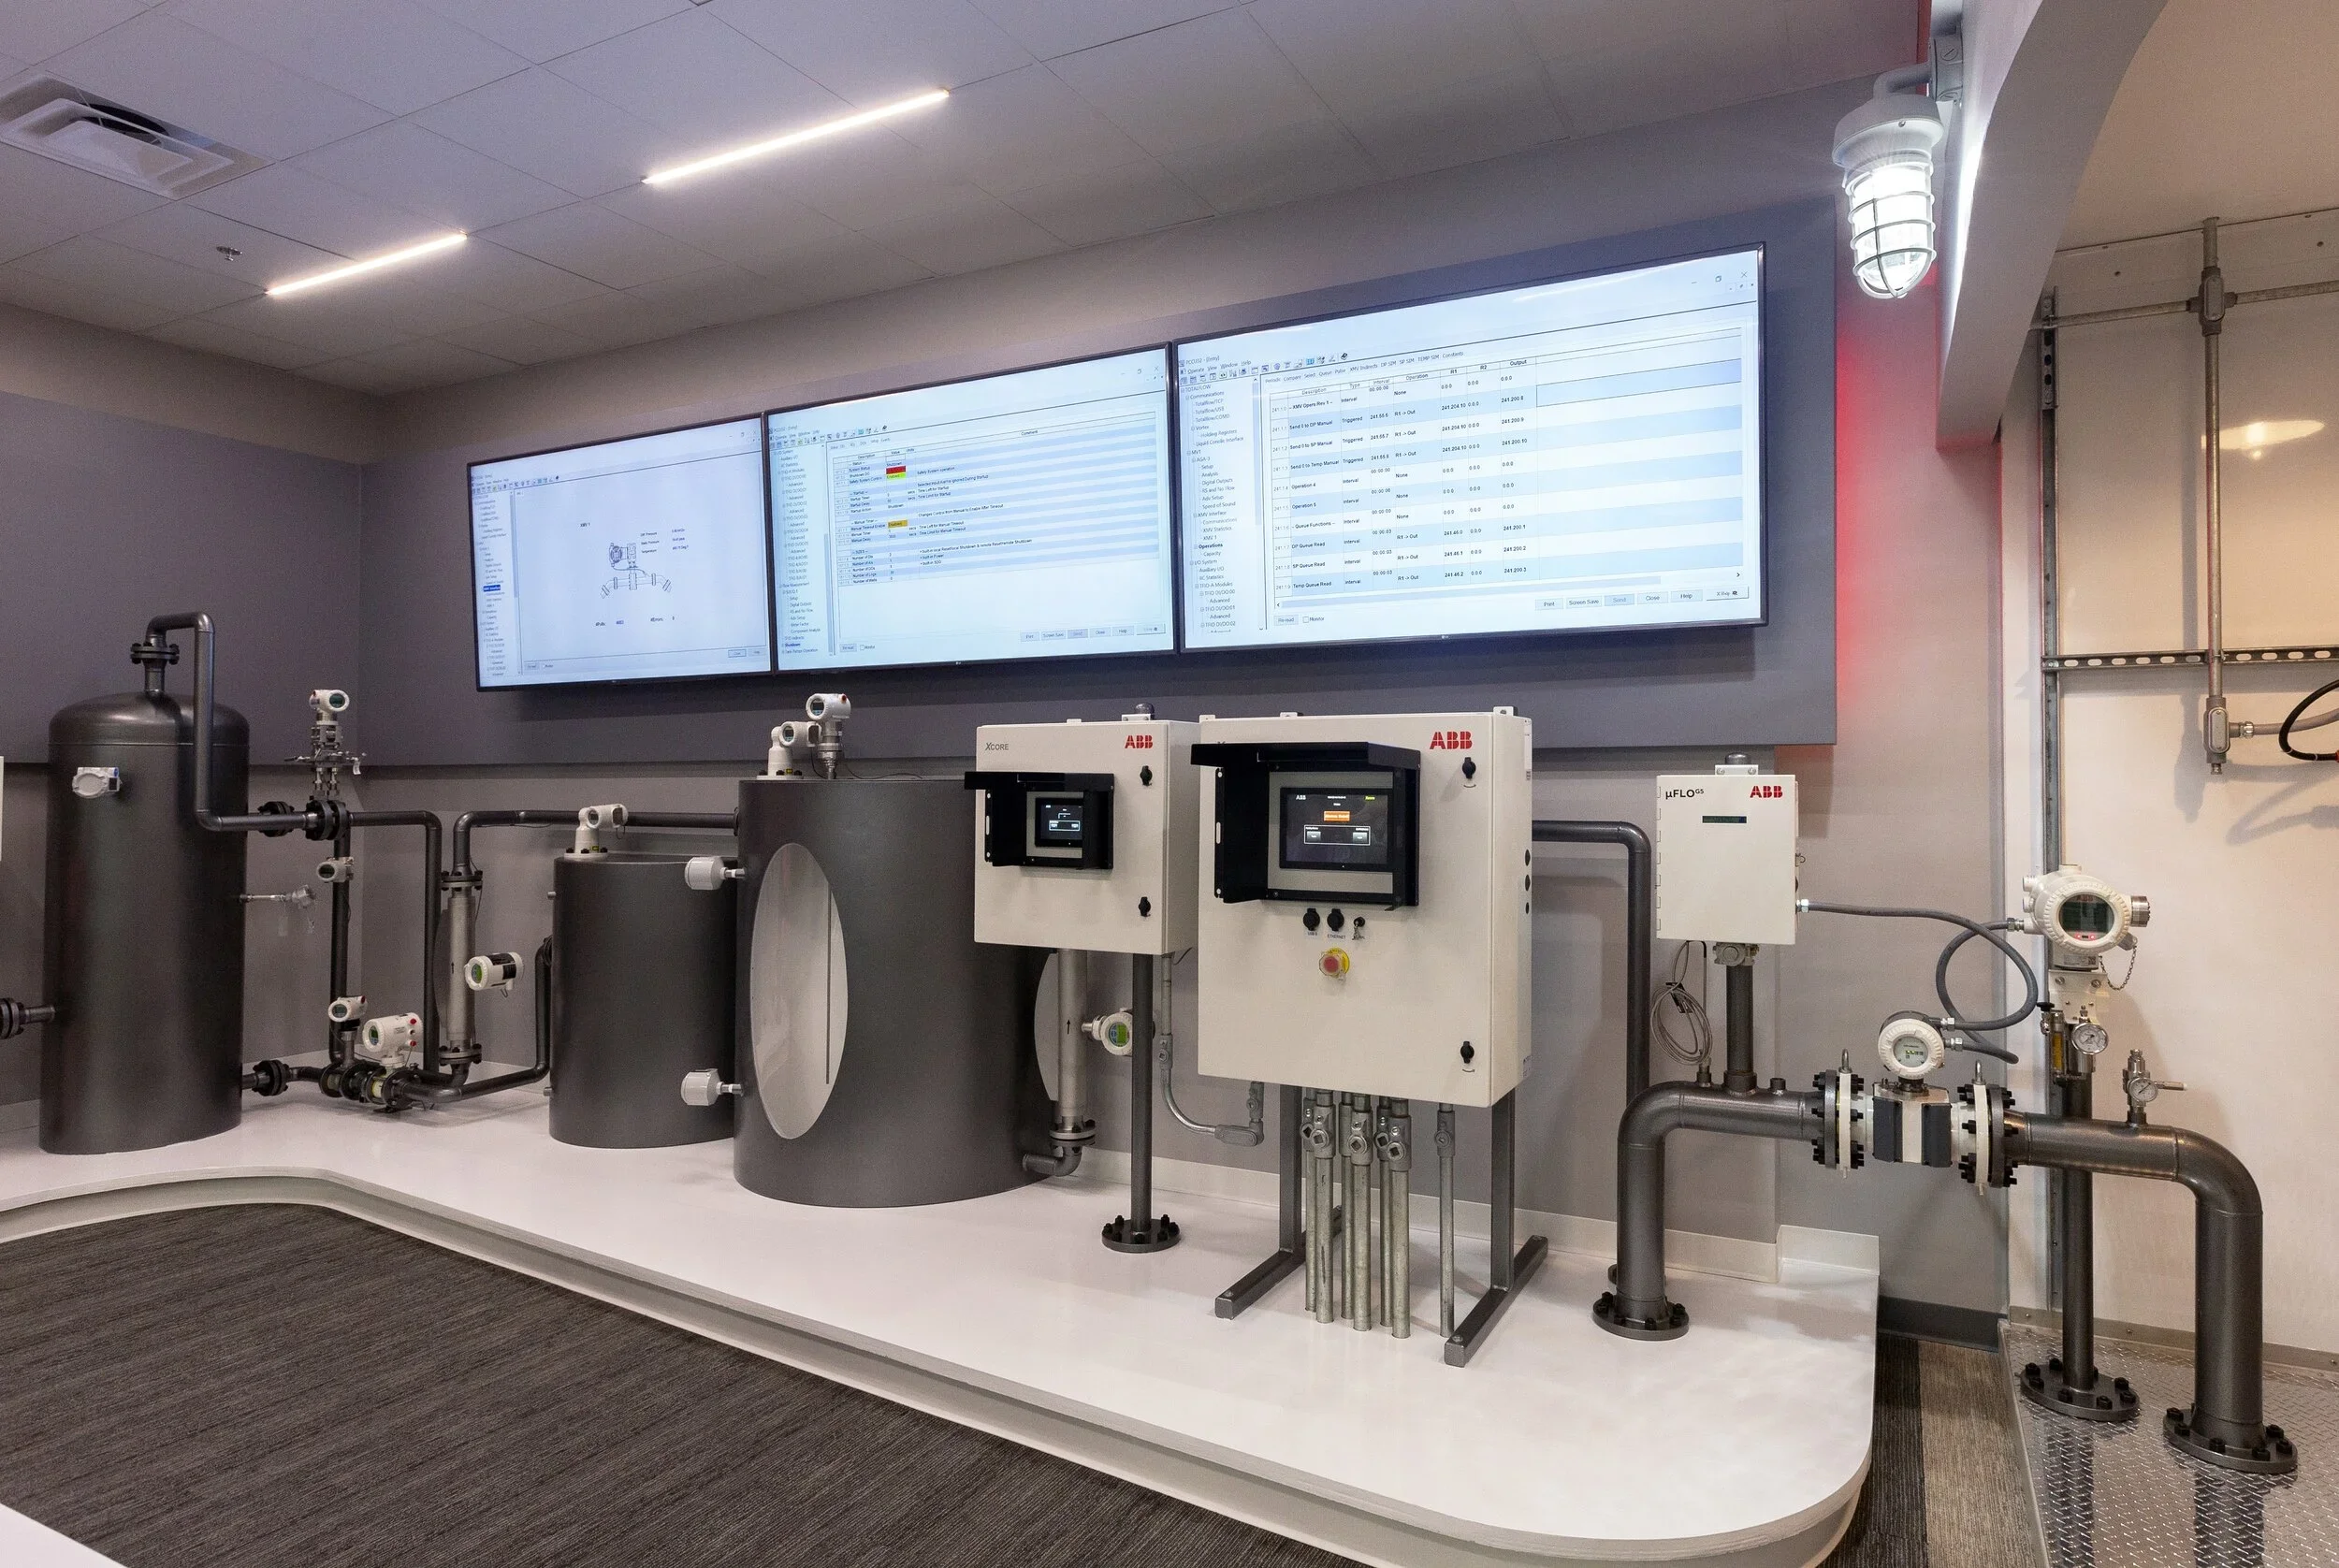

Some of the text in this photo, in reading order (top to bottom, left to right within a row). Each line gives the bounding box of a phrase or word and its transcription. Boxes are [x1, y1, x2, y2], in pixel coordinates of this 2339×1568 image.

[985, 742, 1009, 751] XCORE
[1125, 735, 1153, 749] ABB
[1429, 731, 1473, 750] ABB
[1750, 785, 1783, 798] ABB
